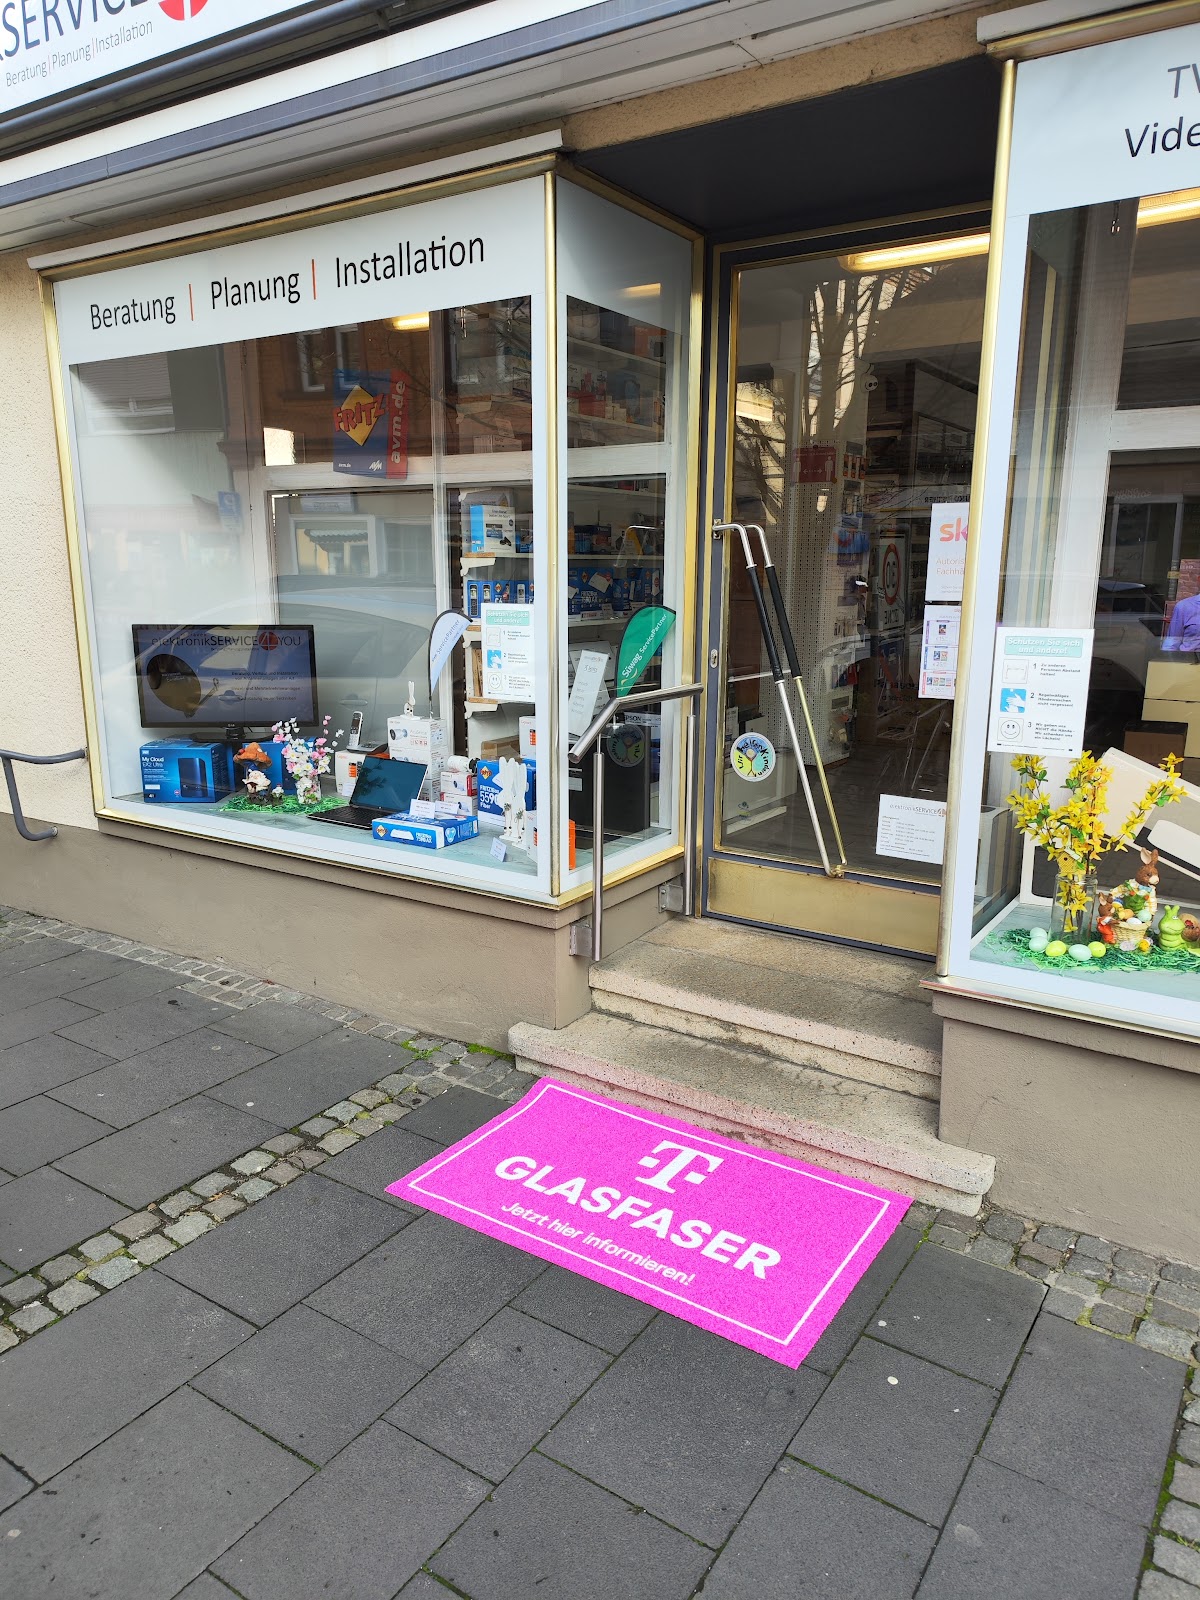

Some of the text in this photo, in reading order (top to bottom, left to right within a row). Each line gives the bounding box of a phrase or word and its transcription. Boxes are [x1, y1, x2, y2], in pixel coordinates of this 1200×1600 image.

[0, 0, 147, 60] SERV
[6, 20, 153, 87] Beratung Planung Installation
[90, 234, 485, 331] Beratung Planung Installation
[391, 380, 405, 463] avm.de
[621, 613, 667, 678] Süwag ServicePartner
[625, 714, 642, 722] PSON
[635, 1140, 724, 1194] T
[495, 1156, 781, 1280] GLASFASER
[501, 1202, 696, 1286] Jetzt hier informieren!
